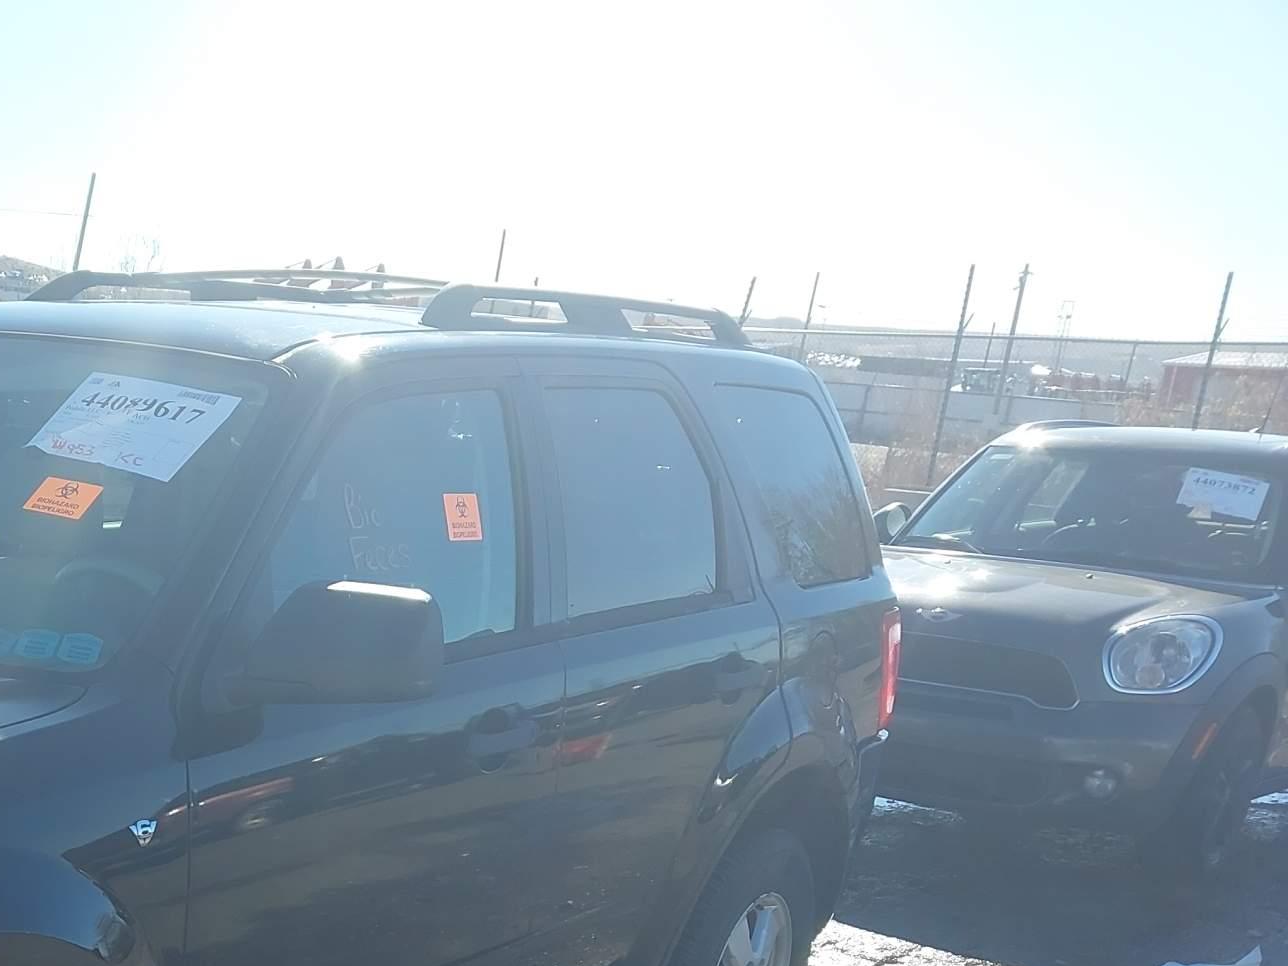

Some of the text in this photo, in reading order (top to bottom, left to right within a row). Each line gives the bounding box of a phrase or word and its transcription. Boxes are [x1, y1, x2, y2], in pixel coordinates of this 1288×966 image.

[81, 391, 206, 425] 44089617
[1192, 476, 1257, 495] 44073872
[36, 496, 80, 510] BIOHAZARD
